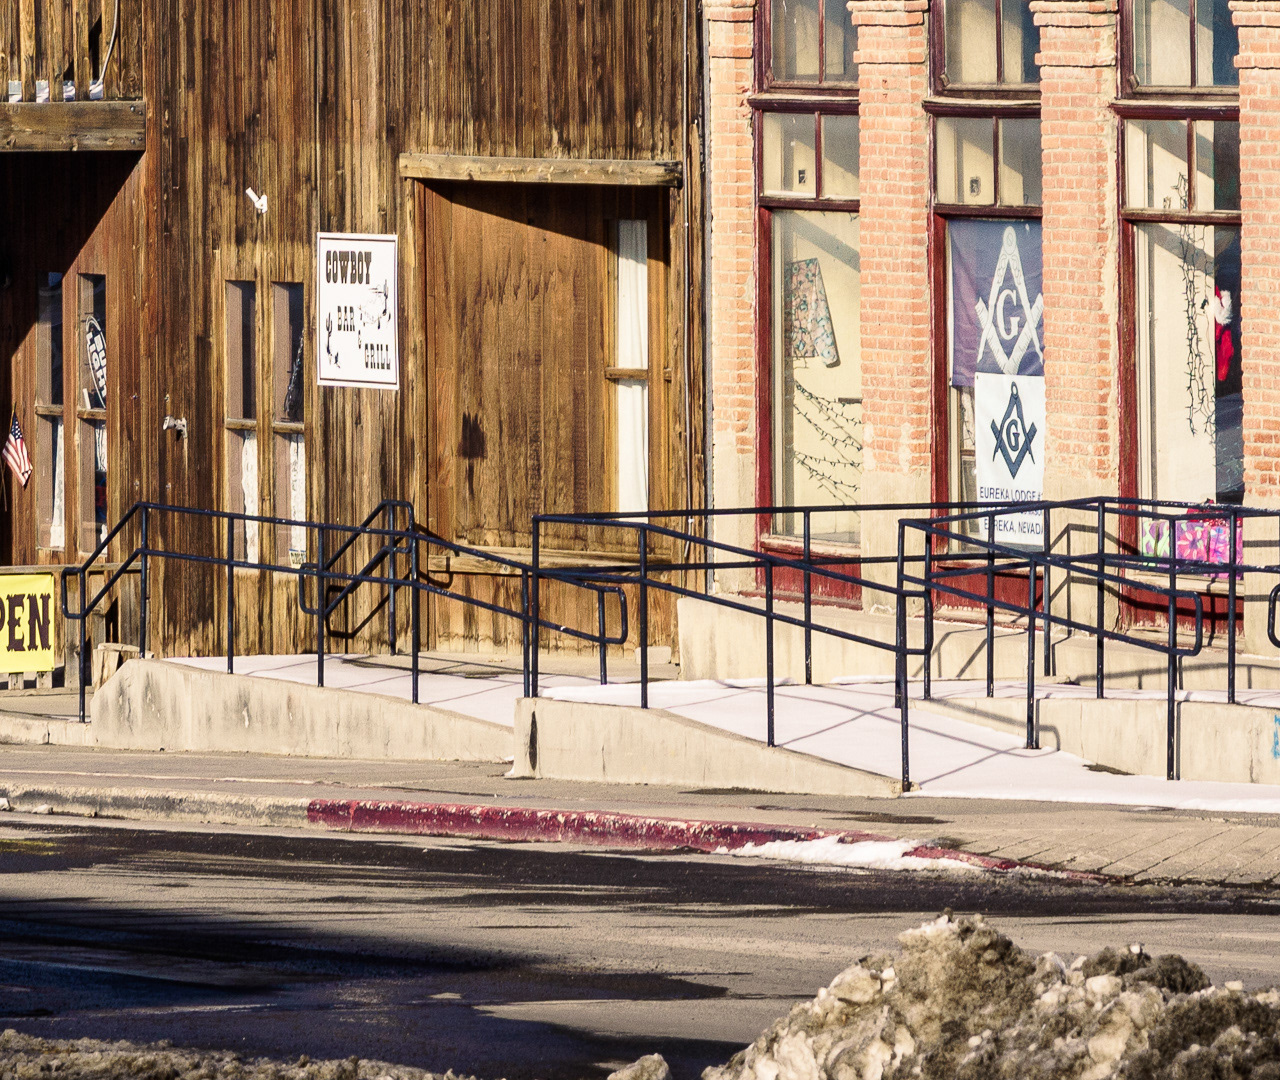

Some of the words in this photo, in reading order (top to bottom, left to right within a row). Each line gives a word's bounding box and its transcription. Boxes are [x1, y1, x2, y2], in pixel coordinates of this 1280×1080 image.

[325, 249, 372, 285] COWBOY
[337, 305, 356, 332] BAR
[364, 342, 392, 370] GRILL
[980, 486, 1009, 500] EUREKA
[984, 518, 1016, 534] EREKA,
